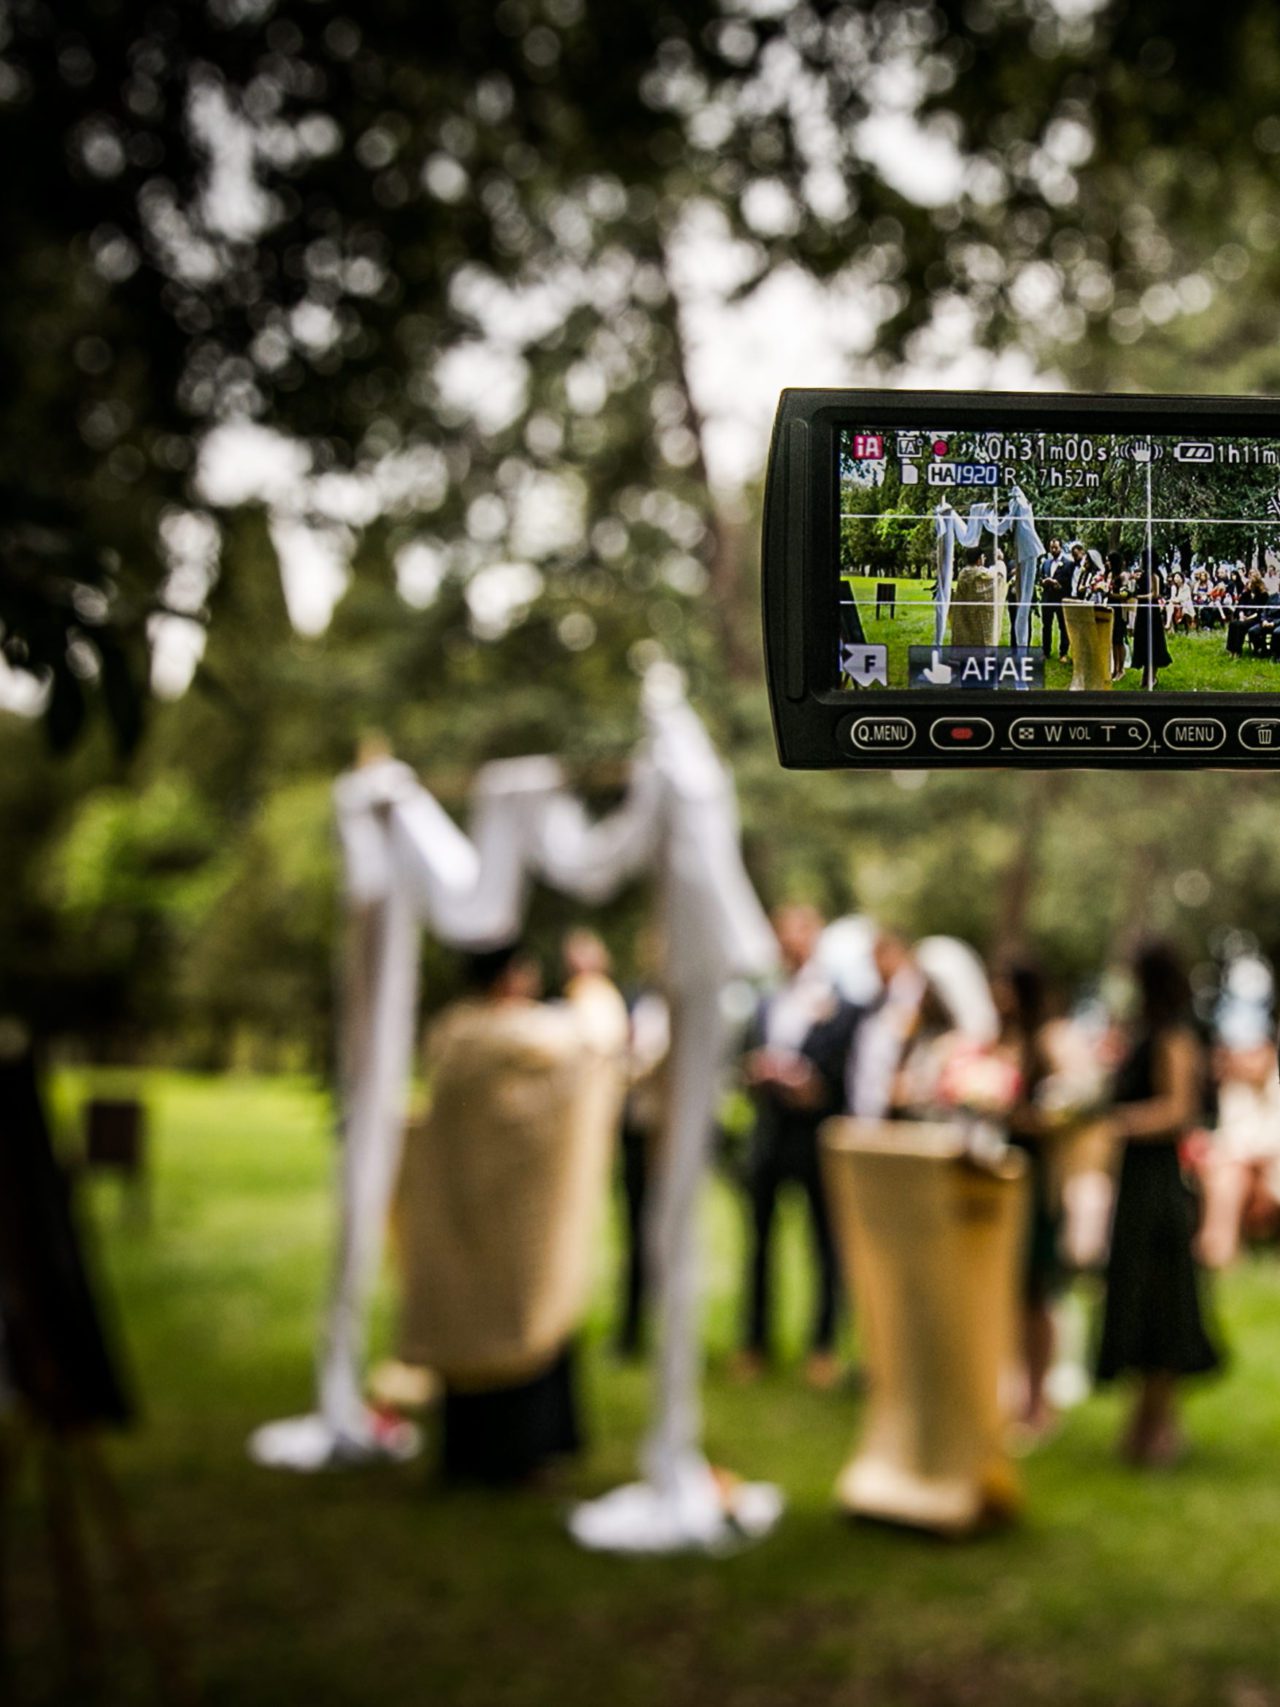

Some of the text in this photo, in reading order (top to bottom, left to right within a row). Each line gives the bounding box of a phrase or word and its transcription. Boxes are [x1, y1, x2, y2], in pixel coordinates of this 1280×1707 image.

[1004, 467, 1017, 485] R
[1039, 468, 1100, 487] 7h52m
[864, 656, 876, 673] F
[858, 726, 908, 742] Q.MENU
[1044, 725, 1116, 742] W VOL T
[1175, 726, 1214, 741] MENU
